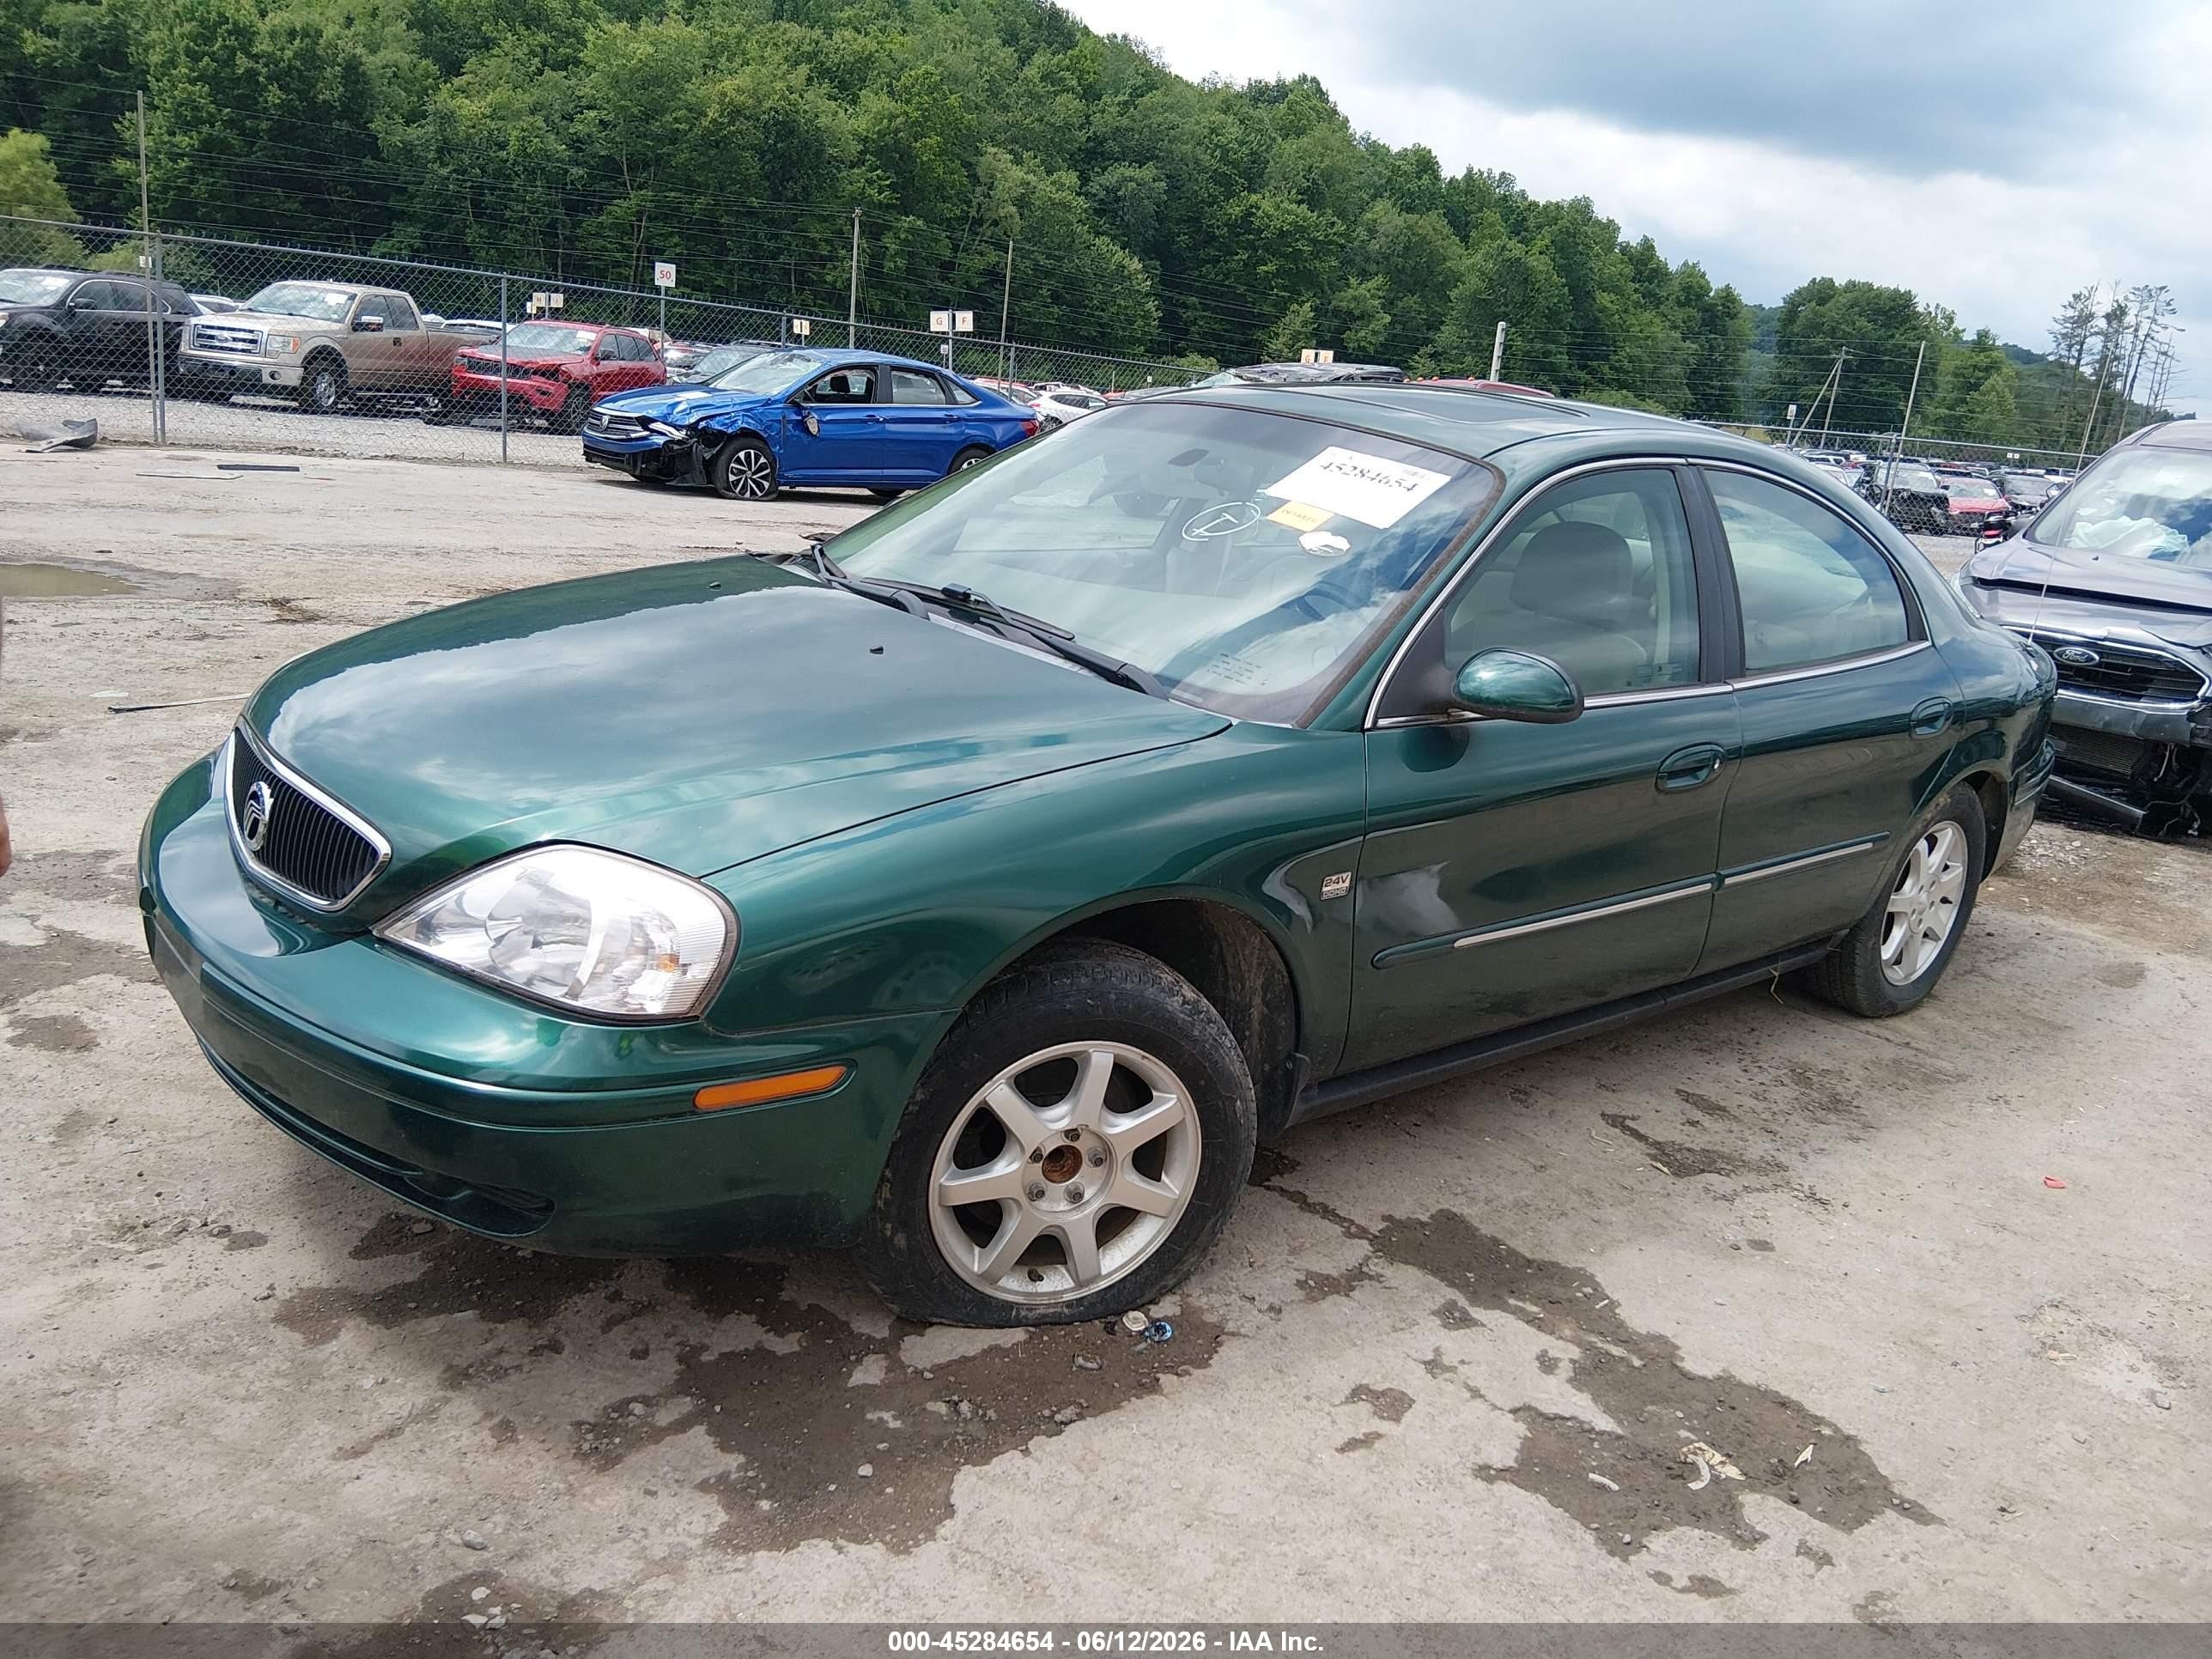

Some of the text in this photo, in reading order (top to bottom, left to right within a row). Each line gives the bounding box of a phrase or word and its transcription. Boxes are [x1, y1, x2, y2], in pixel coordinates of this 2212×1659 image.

[659, 270, 672, 280] 50
[935, 317, 943, 325] G
[962, 317, 968, 325] F
[2062, 649, 2089, 662] Ford
[1324, 874, 1349, 888] 24V
